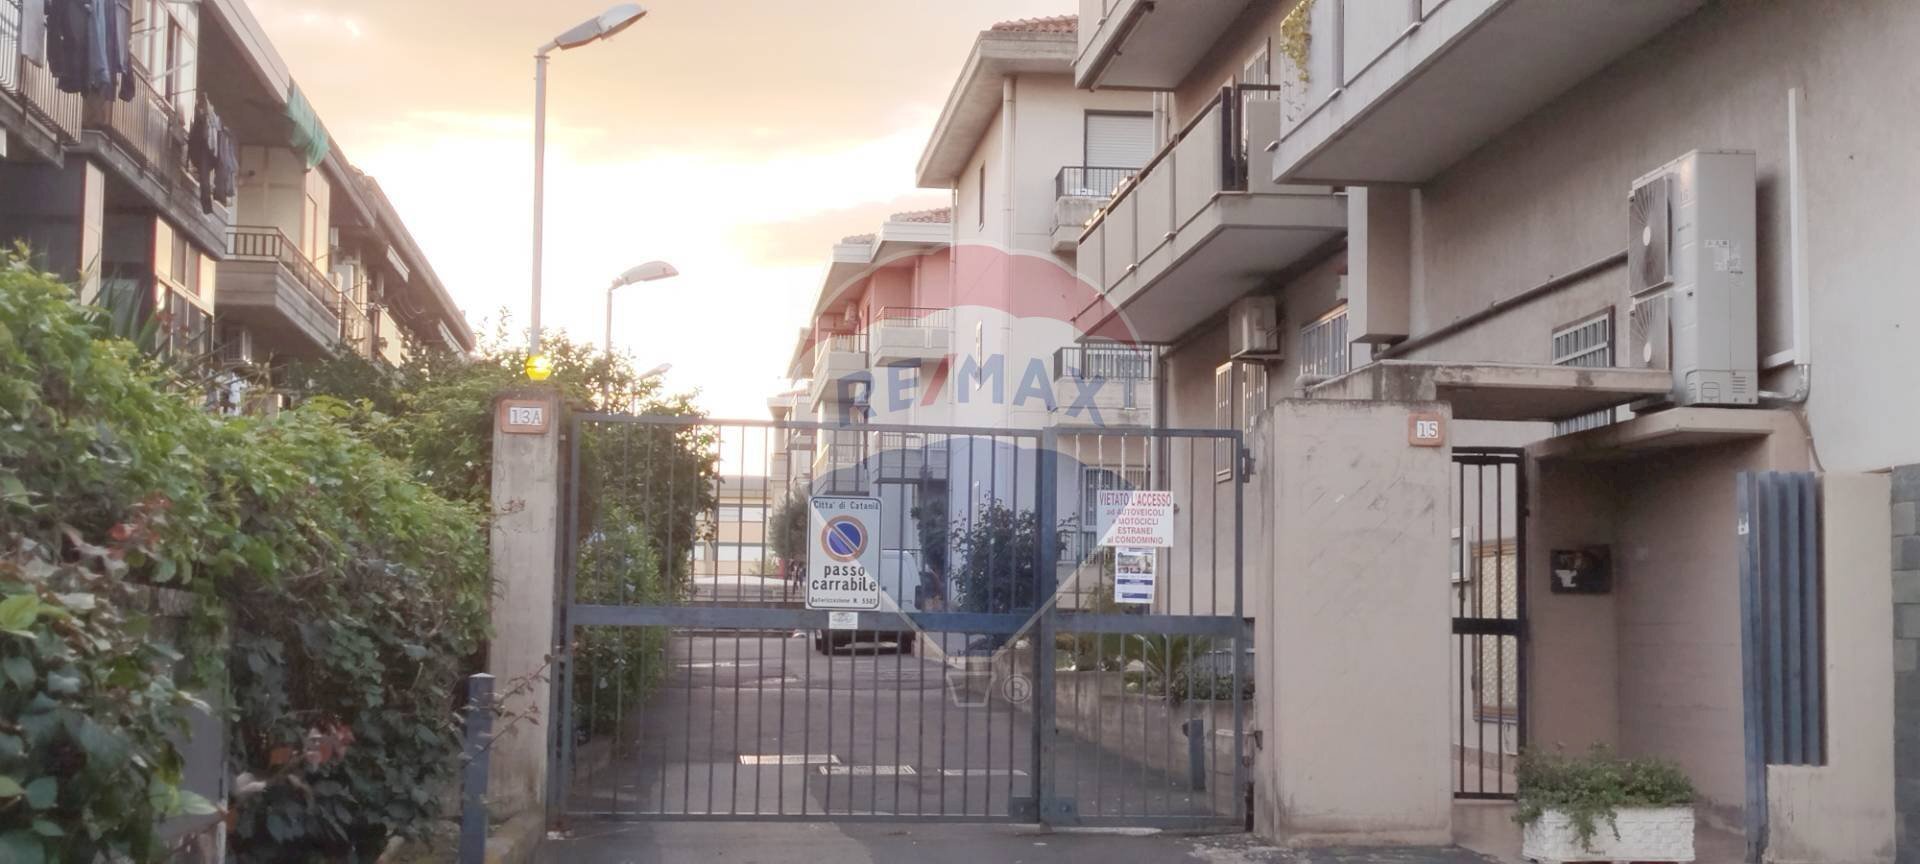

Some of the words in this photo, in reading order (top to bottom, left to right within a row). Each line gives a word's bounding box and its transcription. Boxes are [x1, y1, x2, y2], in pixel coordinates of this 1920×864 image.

[511, 409, 541, 424] 13A
[1419, 422, 1437, 437] 15
[1099, 492, 1129, 506] VIETATO
[1131, 492, 1172, 507] L'ACCESSO
[839, 501, 846, 509] di
[850, 501, 879, 510] Catania
[1117, 508, 1165, 517] AUTOVEICOLI
[1119, 517, 1159, 526] MOTOCICLI
[1117, 526, 1153, 535] ESTRANEI
[1115, 536, 1164, 545] CONDOMINIO
[824, 565, 865, 578] passo
[811, 577, 877, 592] carrabile
